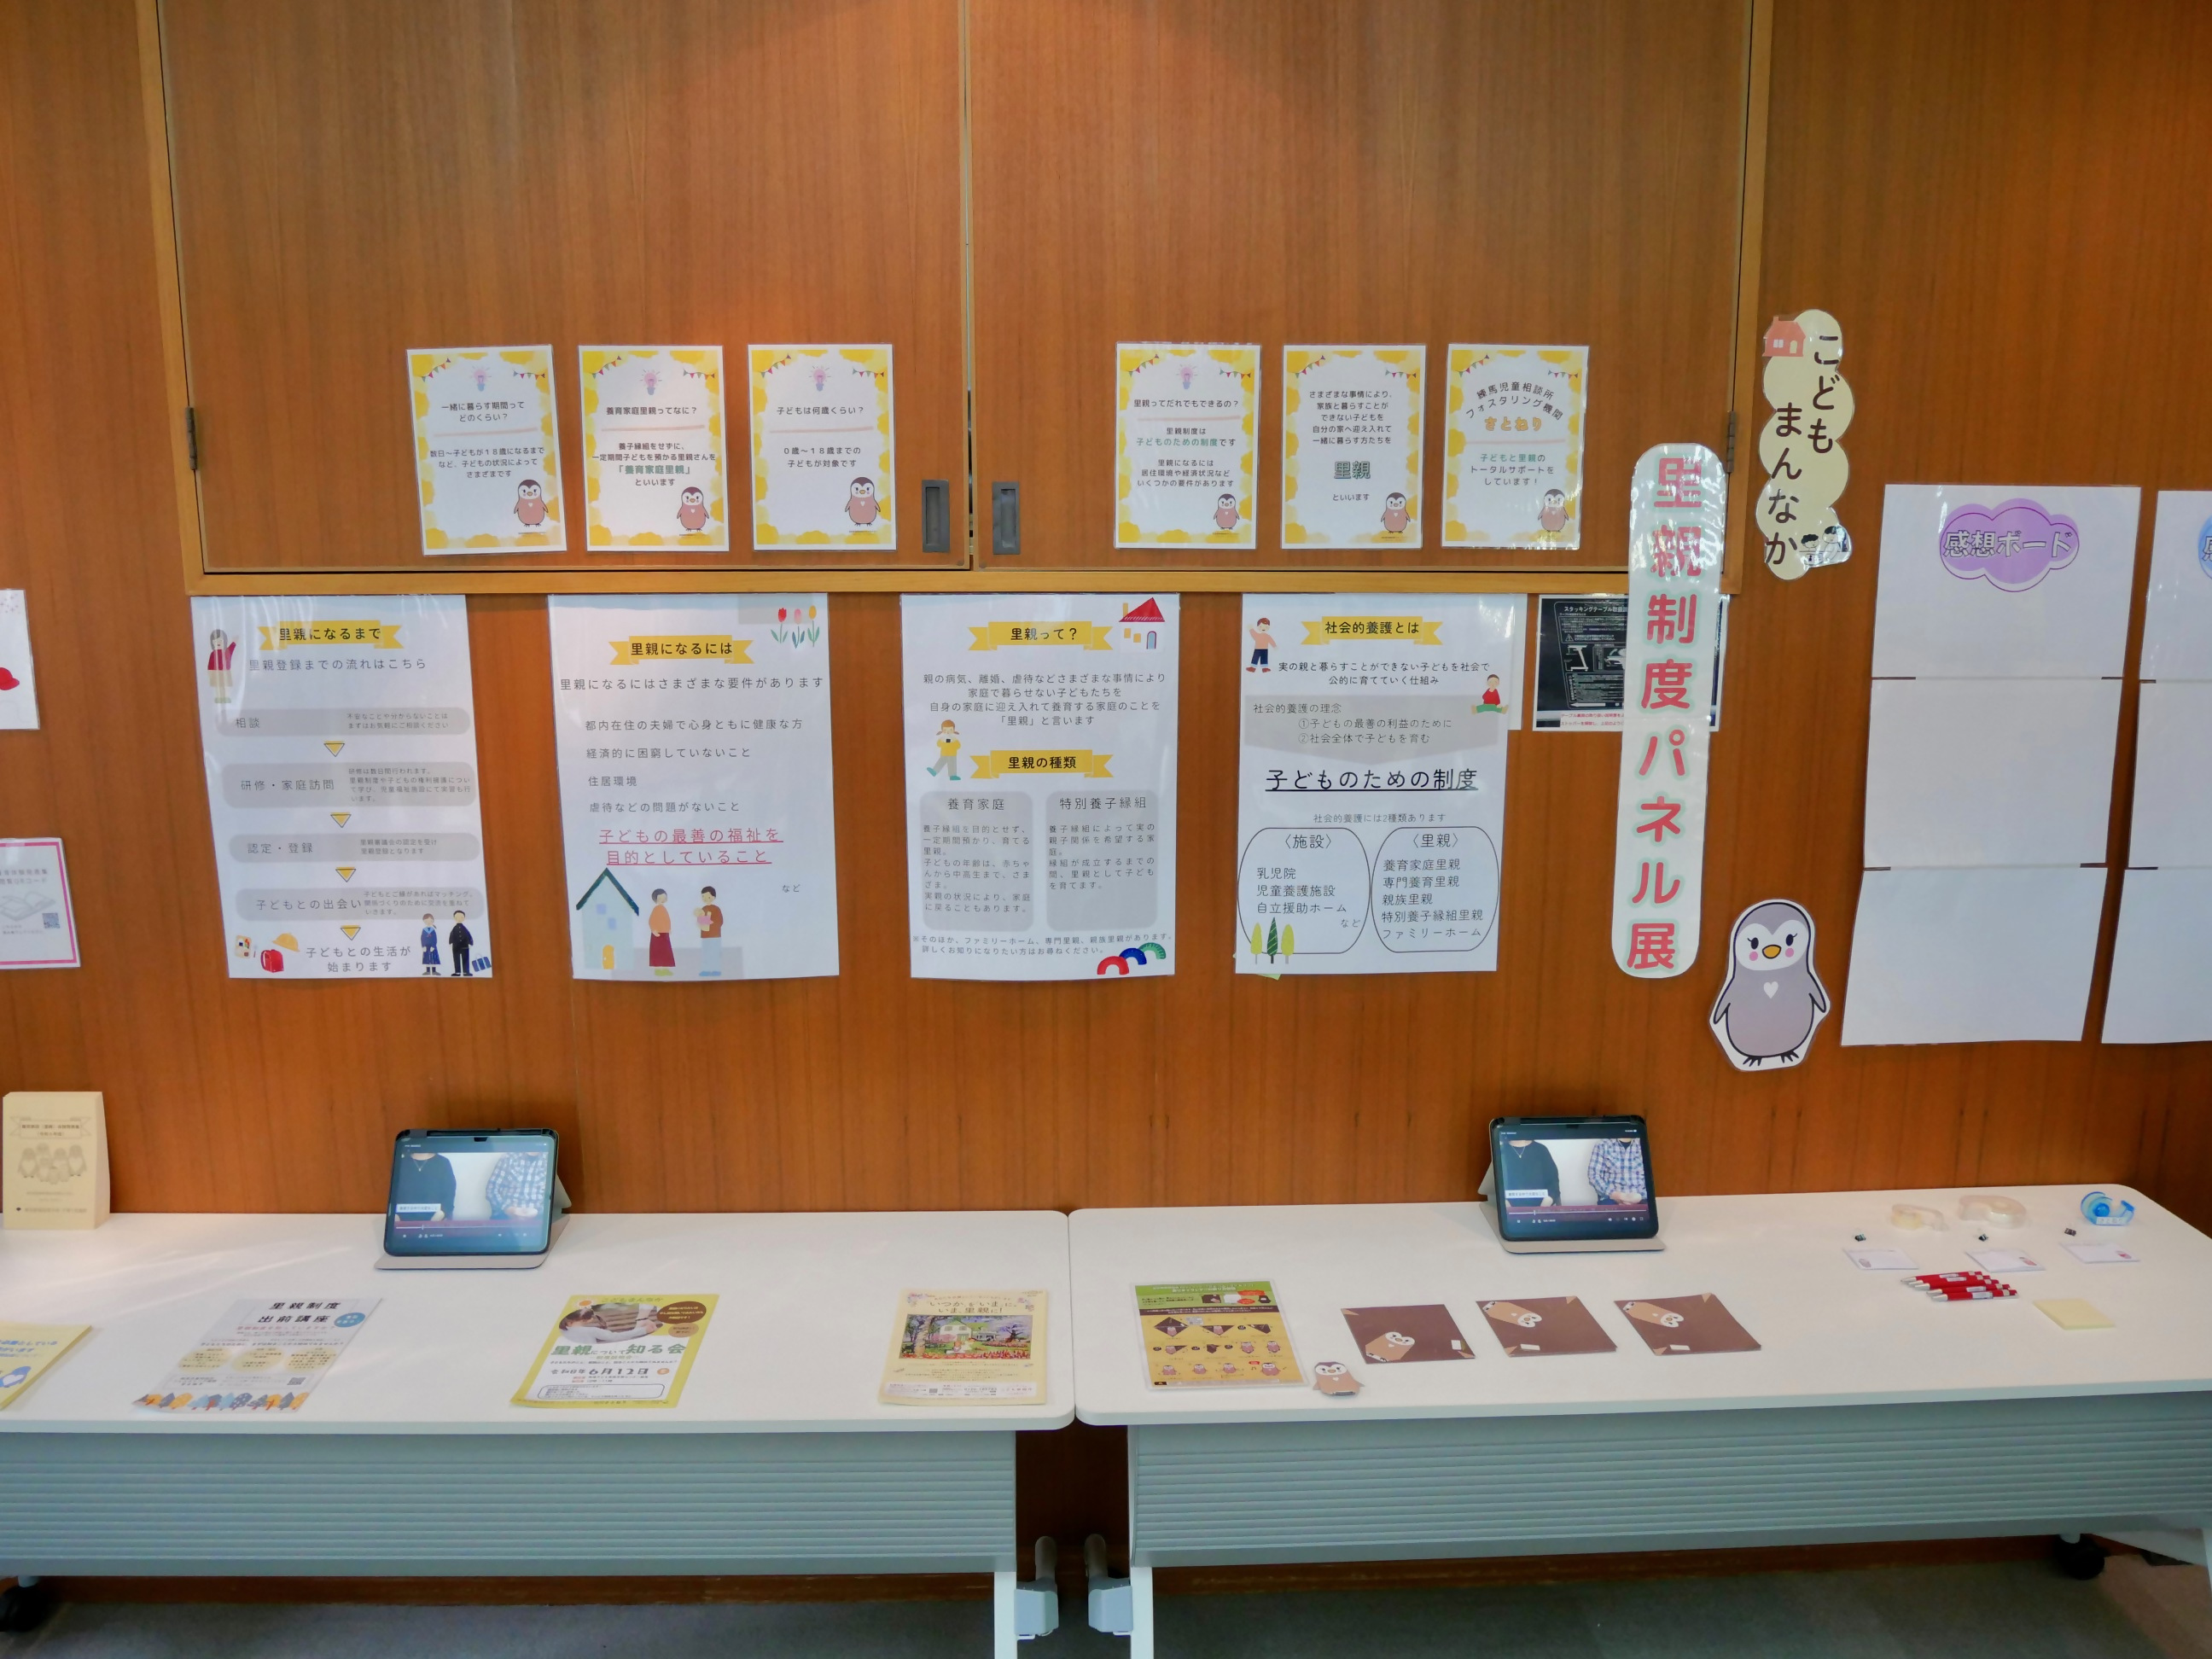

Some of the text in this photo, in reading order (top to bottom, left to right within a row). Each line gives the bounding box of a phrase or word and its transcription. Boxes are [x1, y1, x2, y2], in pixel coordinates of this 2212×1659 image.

[1476, 381, 1555, 400] 練馬児童相談所
[1807, 335, 1840, 454] こども
[441, 401, 525, 411] 一緒に暮らす期間って
[1133, 399, 1238, 408] 里親ってだれでもできるの？
[1317, 402, 1388, 410] 家族と暮らすことが
[1466, 396, 1563, 421] フォスタリング機関
[606, 406, 697, 416] 養育家庭里親ってなに？
[777, 406, 864, 415] 子どもは何歳くらい？
[459, 413, 508, 422] どのくらい？
[1321, 413, 1384, 422] できない子どもを
[1484, 416, 1542, 431] さとねり
[1166, 428, 1207, 436] 里親制度は
[1313, 425, 1392, 434] 自分の家へ迎え入れて
[1137, 438, 1236, 447] 子どものための制度です
[1313, 436, 1392, 445] 一緒に暮らす方たちを
[591, 453, 716, 462] 一定期間子どもを預かる里親さんを
[1480, 454, 1545, 463] 子どもと里親の
[788, 459, 857, 468] 子どもが対象です
[466, 469, 511, 479] さまざまです
[617, 464, 691, 475] 「養育家庭里親」
[1141, 469, 1230, 478] 居住環境や経済状況など
[1334, 461, 1371, 480] 里親
[1470, 465, 1554, 474] トータルサポートを
[634, 478, 675, 486] といいます
[1137, 479, 1234, 488] いくつかの要件があります
[1766, 402, 1802, 564] まんなか
[1332, 493, 1370, 502] といいます
[1942, 530, 2072, 558] 感想ボード
[1324, 621, 1420, 635] 社会的養護とは
[280, 628, 381, 641] 里親になるまで
[1010, 628, 1078, 641] 里親って？
[631, 642, 733, 655] 里親になるには
[249, 658, 426, 672] 里親登録までの流れはこちら
[1278, 661, 1490, 672] 実の親と暮らすことができない子どもを社会で
[560, 676, 824, 690] 里親になるにはさまざまな要件があります
[1329, 675, 1439, 685] 公的に育てていく仕組み
[968, 687, 1121, 698] 家庭で暮らせない子どもたちを
[929, 701, 1160, 713] 自身の家庭に迎え入れて養育する家庭のことを
[1254, 703, 1342, 714] 社会的養護の理念
[1627, 457, 1703, 969] 里親制度パネル展
[236, 717, 260, 728] 相談
[585, 719, 802, 731] 都内在住の夫婦で心身ともに健康な方
[1000, 715, 1095, 726] 「里親」と言います
[586, 747, 751, 759] 経済的に困窮していないこと
[1008, 756, 1077, 769] 里親の種類
[588, 776, 637, 787] 住居環境
[1266, 769, 1478, 789] 子どものための制度
[241, 779, 335, 791] 研修・家庭訪問
[590, 801, 740, 812] 虐待などの問題がないこと
[947, 798, 1005, 811] 養育家庭
[1059, 796, 1147, 811] 特別養子縁組
[1313, 812, 1446, 824] 社会的養護には2種類あります
[1049, 824, 1155, 833] 養子縁組によって実の
[599, 828, 778, 843] 子どもの最善の福祉を
[1049, 835, 1155, 844] 親子関係を希望する家
[247, 841, 313, 854] 認定・登録
[607, 849, 767, 864] 目的としていること
[1049, 857, 1155, 867] 縁組が成立するまでの
[1383, 859, 1461, 871] 養育家庭里親
[1256, 867, 1296, 880] 乳児院
[1382, 876, 1460, 888] 専門養育里親
[782, 884, 800, 893] など
[1256, 885, 1336, 897] 児童養護施設
[256, 899, 362, 910] 子どもとの出会い
[1382, 894, 1433, 905] 親族里親
[1257, 902, 1347, 914] 自立援助ホーム
[1381, 910, 1483, 923] 特別養子縁組里親
[1341, 919, 1360, 928] など
[1382, 928, 1481, 940] ファミリーホーム
[306, 946, 410, 958] 子どもとの生活が
[328, 962, 392, 973] 始まります
